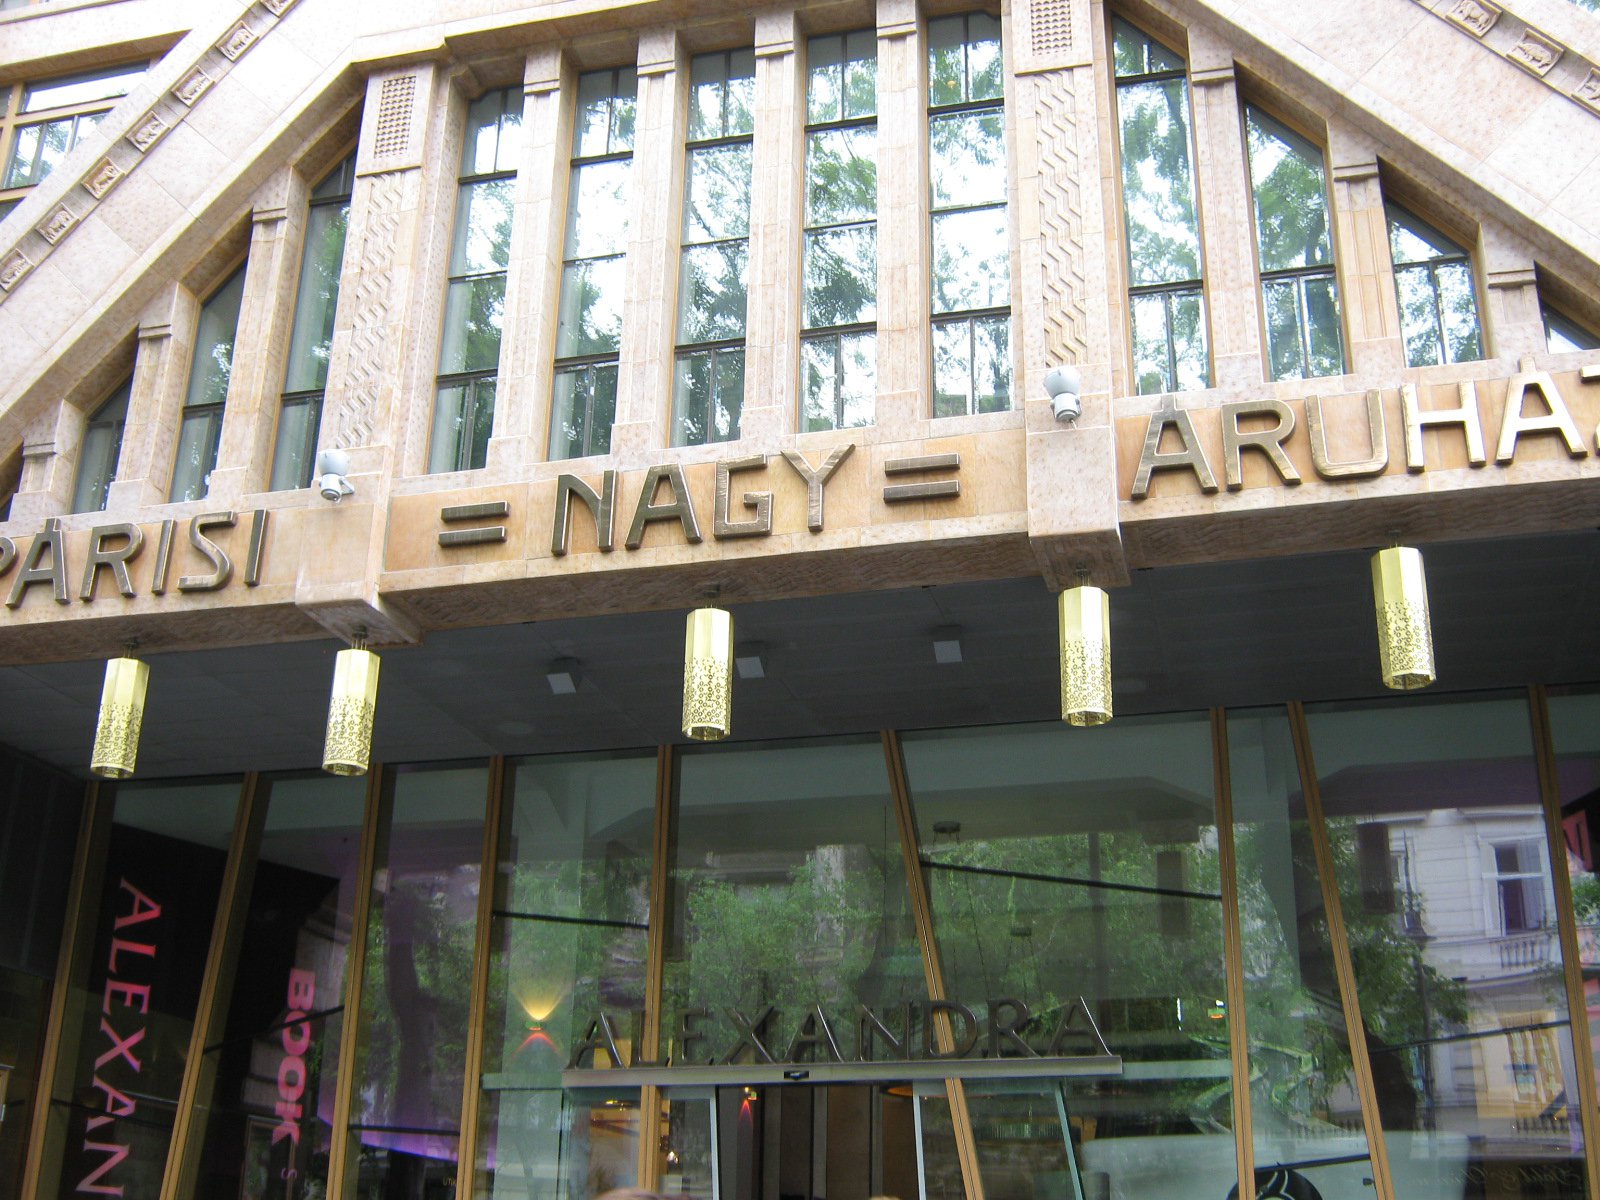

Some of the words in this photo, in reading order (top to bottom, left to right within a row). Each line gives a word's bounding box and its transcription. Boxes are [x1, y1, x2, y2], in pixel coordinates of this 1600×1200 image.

[551, 443, 856, 557] NAGY
[1130, 355, 1600, 500] ÁRUHÁ
[272, 967, 316, 1146] BOOK
[564, 996, 1114, 1069] ALEXANDRA
